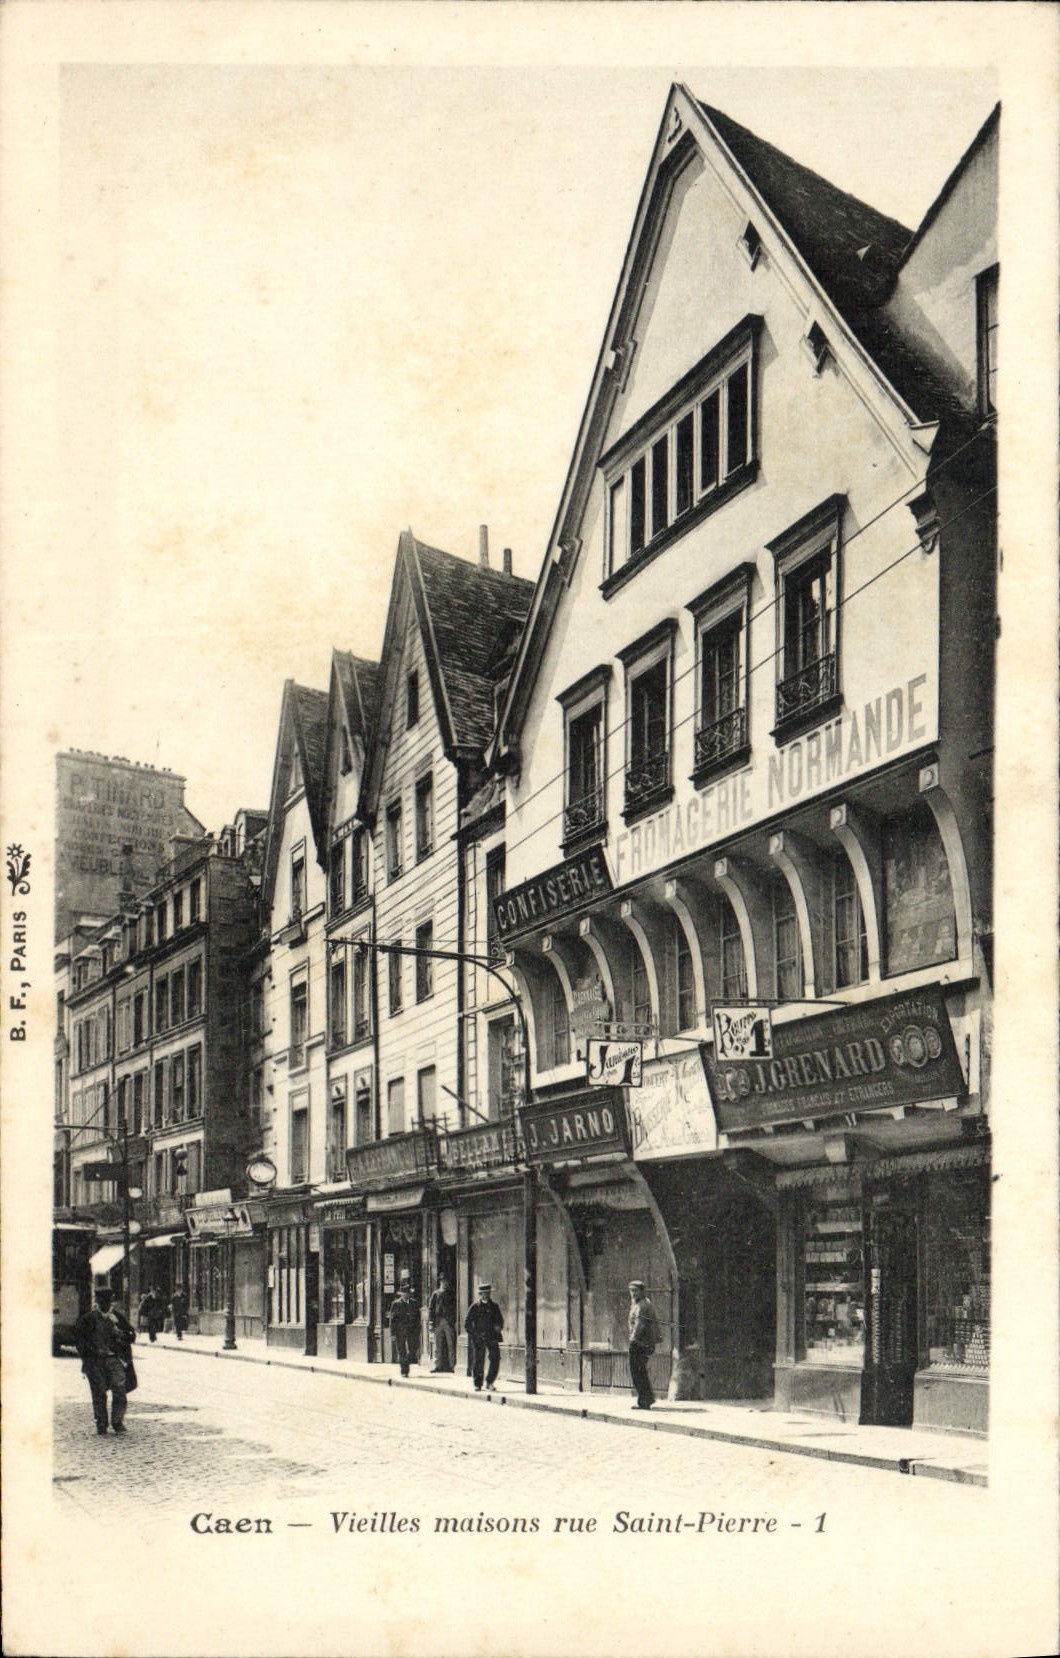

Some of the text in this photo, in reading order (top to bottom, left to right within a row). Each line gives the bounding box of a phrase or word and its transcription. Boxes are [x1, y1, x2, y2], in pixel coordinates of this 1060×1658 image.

[615, 673, 928, 879] FROMAGERIE NORMANDE
[496, 854, 605, 930] CONFISERIE
[881, 1000, 941, 1033] EXPORTATION
